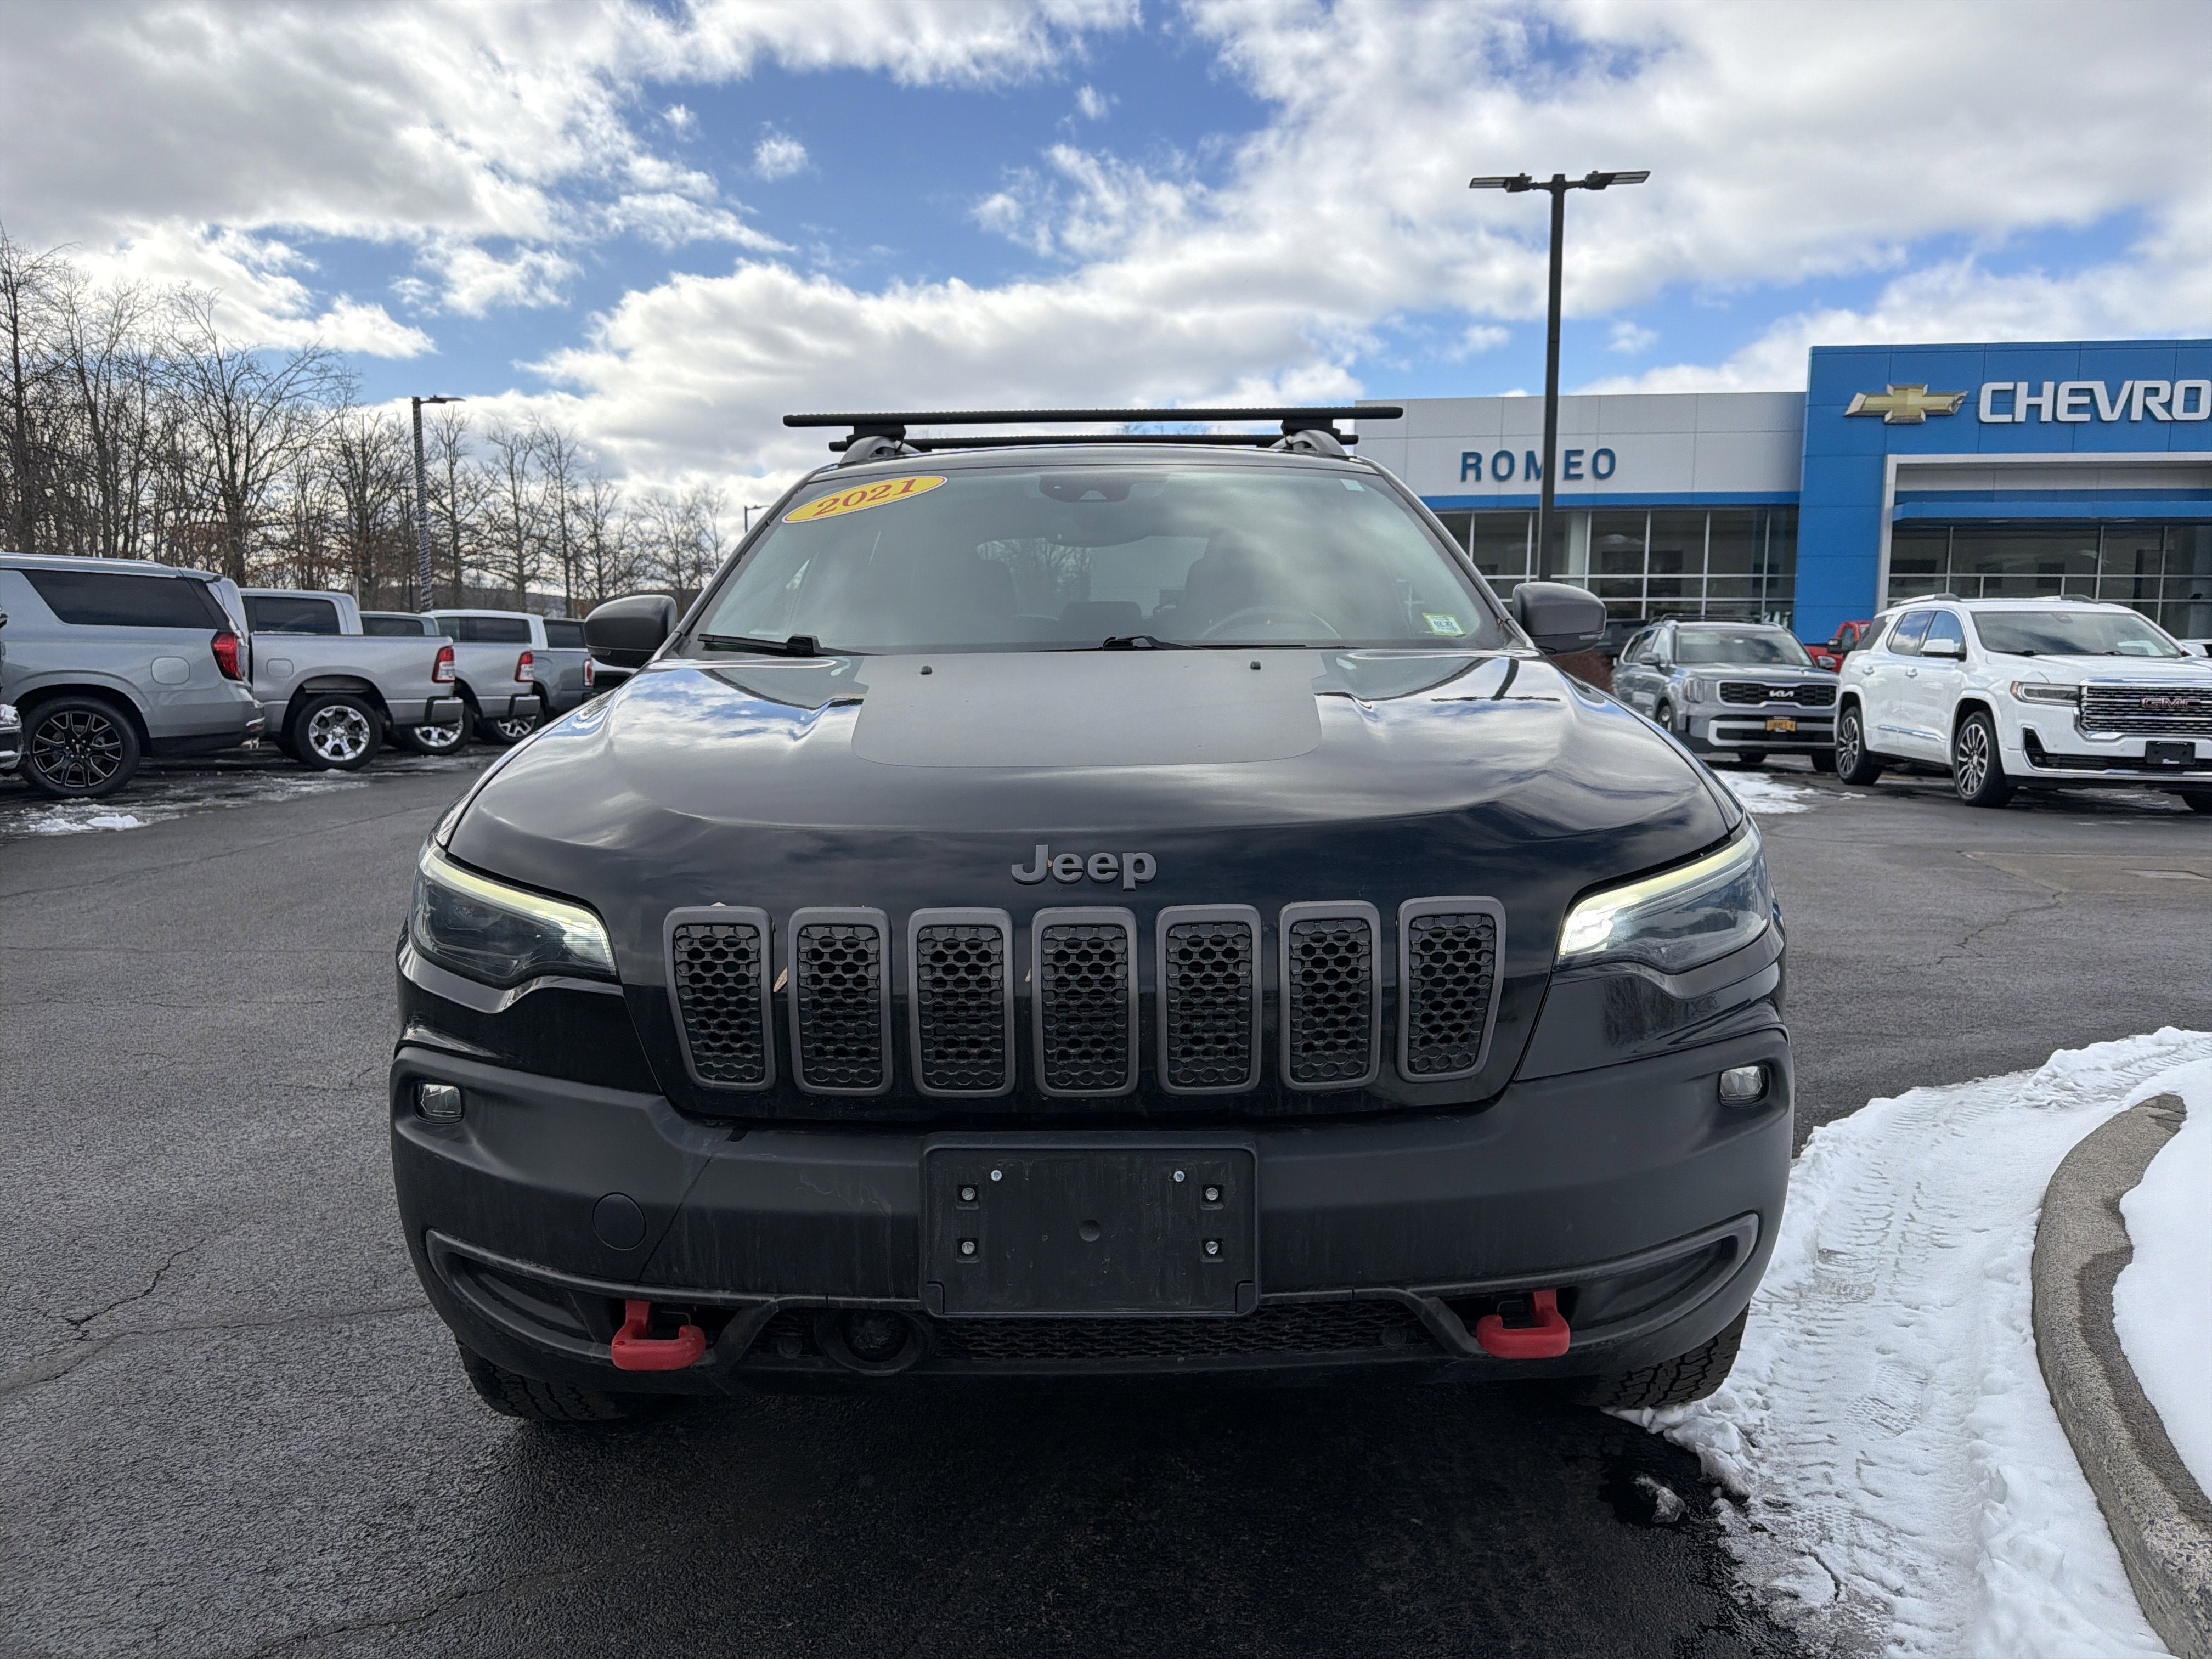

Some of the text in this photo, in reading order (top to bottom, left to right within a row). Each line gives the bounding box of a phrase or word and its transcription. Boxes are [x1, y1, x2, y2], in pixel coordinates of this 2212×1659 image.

[1978, 380, 2211, 423] CHEVRO
[812, 479, 917, 517] 2021
[2142, 697, 2200, 709] GMC
[1012, 844, 1157, 891] Jeep
